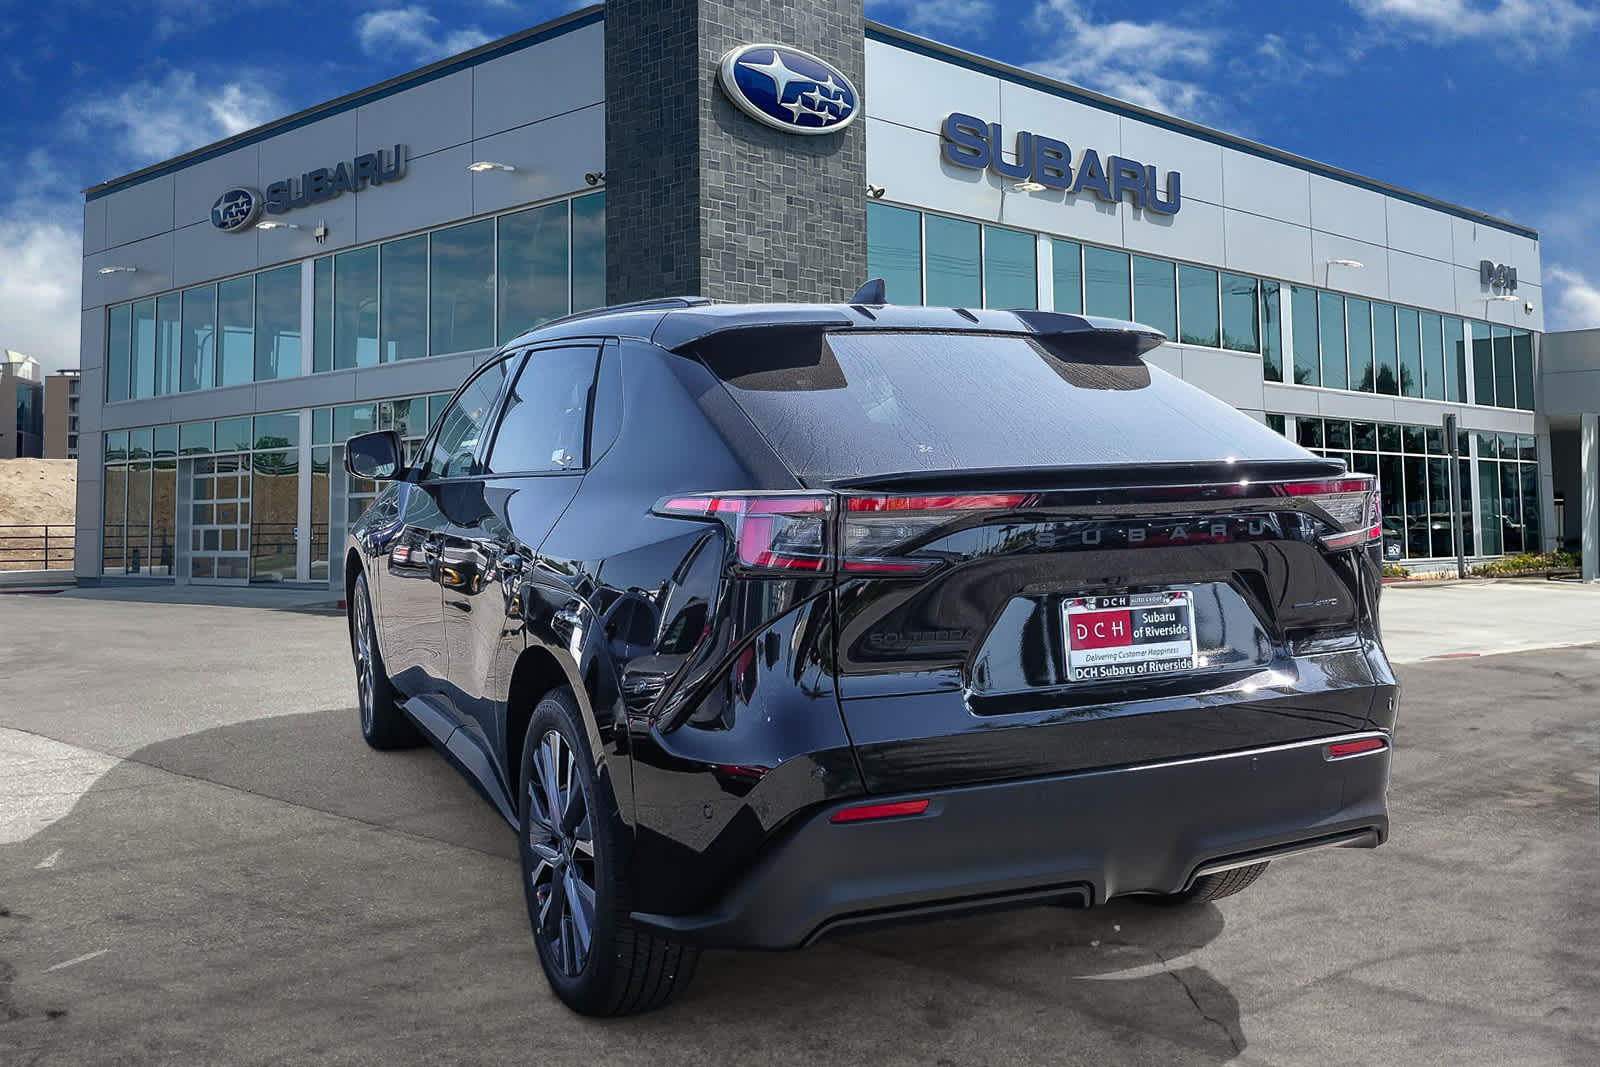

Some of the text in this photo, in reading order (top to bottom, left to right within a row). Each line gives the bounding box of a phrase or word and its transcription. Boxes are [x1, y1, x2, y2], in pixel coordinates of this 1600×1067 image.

[942, 112, 1181, 215] SUBARU
[265, 143, 404, 215] SUBARU
[1035, 520, 1264, 547] SUBARU
[1103, 598, 1126, 607] DCH
[1142, 611, 1176, 624] Subaru
[1076, 621, 1124, 640] DCH
[1133, 623, 1188, 638] of Riverside
[1086, 647, 1179, 663] Delivering Customer Happiness
[1075, 658, 1192, 679] DCH Subaru of Riverside
